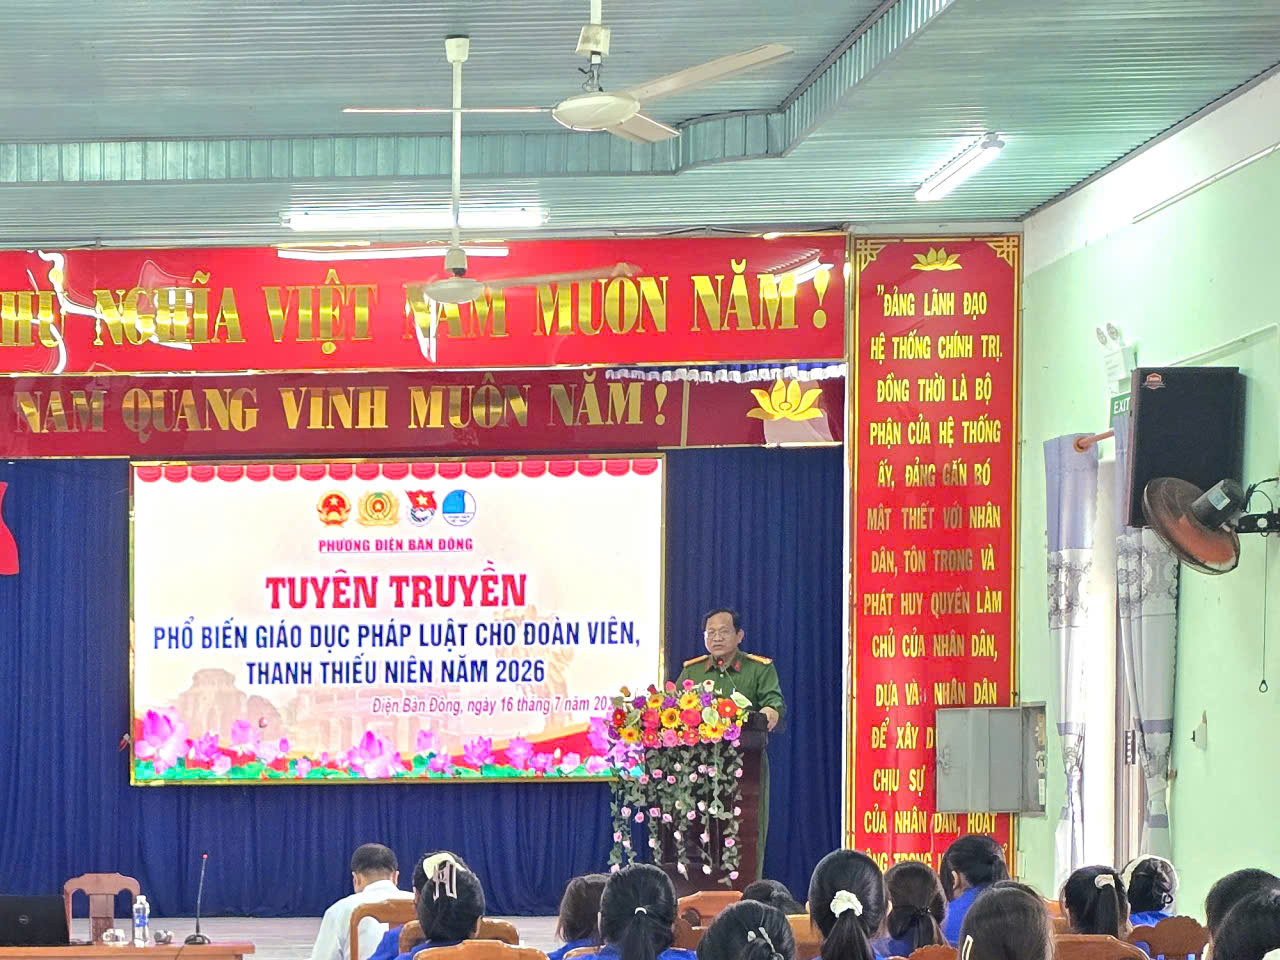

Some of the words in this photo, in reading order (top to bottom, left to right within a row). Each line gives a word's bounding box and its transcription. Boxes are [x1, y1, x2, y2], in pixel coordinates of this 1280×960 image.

[93, 270, 246, 345] NGHĨA
[262, 268, 378, 354] VIỆT
[402, 281, 509, 339] NAM
[533, 262, 669, 336] MUÔN
[924, 288, 955, 316] LÃNH
[963, 291, 987, 321] ĐẠO
[870, 332, 885, 365] HỆ
[892, 329, 931, 360] THỐNG
[938, 330, 973, 359] CHÍNH
[877, 372, 910, 402] ĐỒNG
[918, 372, 945, 402] THỜI
[952, 373, 967, 401] LÀ
[975, 372, 992, 405] BỘ
[16, 390, 105, 433] NAM
[122, 387, 258, 443] QUANG
[278, 386, 389, 429] VINH
[408, 372, 531, 429] MUÔN
[870, 417, 901, 449] PHẬN
[908, 413, 931, 445] CỦA
[939, 416, 954, 448] HỆ
[962, 414, 1001, 444] THỐNG
[905, 456, 936, 487] ĐẢNG
[942, 457, 967, 487] GẮN
[974, 457, 991, 486] BÓ
[867, 502, 892, 534] MẬT
[901, 500, 935, 530] THIẾT
[943, 500, 963, 529] VỚI
[969, 501, 1001, 529] NHÂN
[871, 545, 898, 577] DÂN,
[903, 544, 926, 573] TÔN
[933, 548, 973, 576] TRỌNG
[980, 543, 995, 571] VÀ
[265, 569, 378, 609] TUYÊN
[389, 560, 527, 608] TRUYỀN
[863, 588, 894, 615] PHÁT
[900, 593, 923, 615] HUY
[930, 584, 970, 619] QUYỀN
[976, 585, 1002, 614] LÀM
[153, 616, 195, 649] PHỔ
[202, 617, 248, 649] BIẾN
[256, 620, 302, 648] GIÁO
[310, 624, 349, 653] DỤC
[358, 618, 411, 647] PHÁP
[419, 618, 468, 652] LUẬT
[475, 623, 516, 646] CHO
[523, 616, 580, 645] ĐOÀN
[587, 616, 640, 647] VIÊN,
[871, 627, 895, 658] CHỦ
[902, 627, 926, 658] CỦA
[933, 629, 965, 657] NHÂN
[971, 628, 998, 662] DÂN,
[247, 661, 312, 685] THANH
[320, 652, 376, 684] THIẾU
[385, 655, 433, 683] NIÊN
[441, 654, 488, 683] NĂM
[496, 659, 545, 682] 2026
[373, 697, 399, 716] Điện
[402, 697, 426, 713] Bàn
[467, 697, 497, 716] ngày
[501, 696, 514, 711] 16
[517, 696, 551, 715] tháng
[554, 696, 561, 711] 7
[564, 696, 590, 711] năm
[875, 680, 899, 712] DỰA
[934, 678, 966, 705] NHÂN
[973, 678, 997, 705] DÂN
[871, 717, 890, 749] ĐỂ
[895, 721, 919, 749] XÂY
[873, 768, 900, 796] CHỊU
[909, 764, 926, 797] SỰ
[864, 804, 887, 833] CỦA
[895, 806, 927, 833] NHÂN
